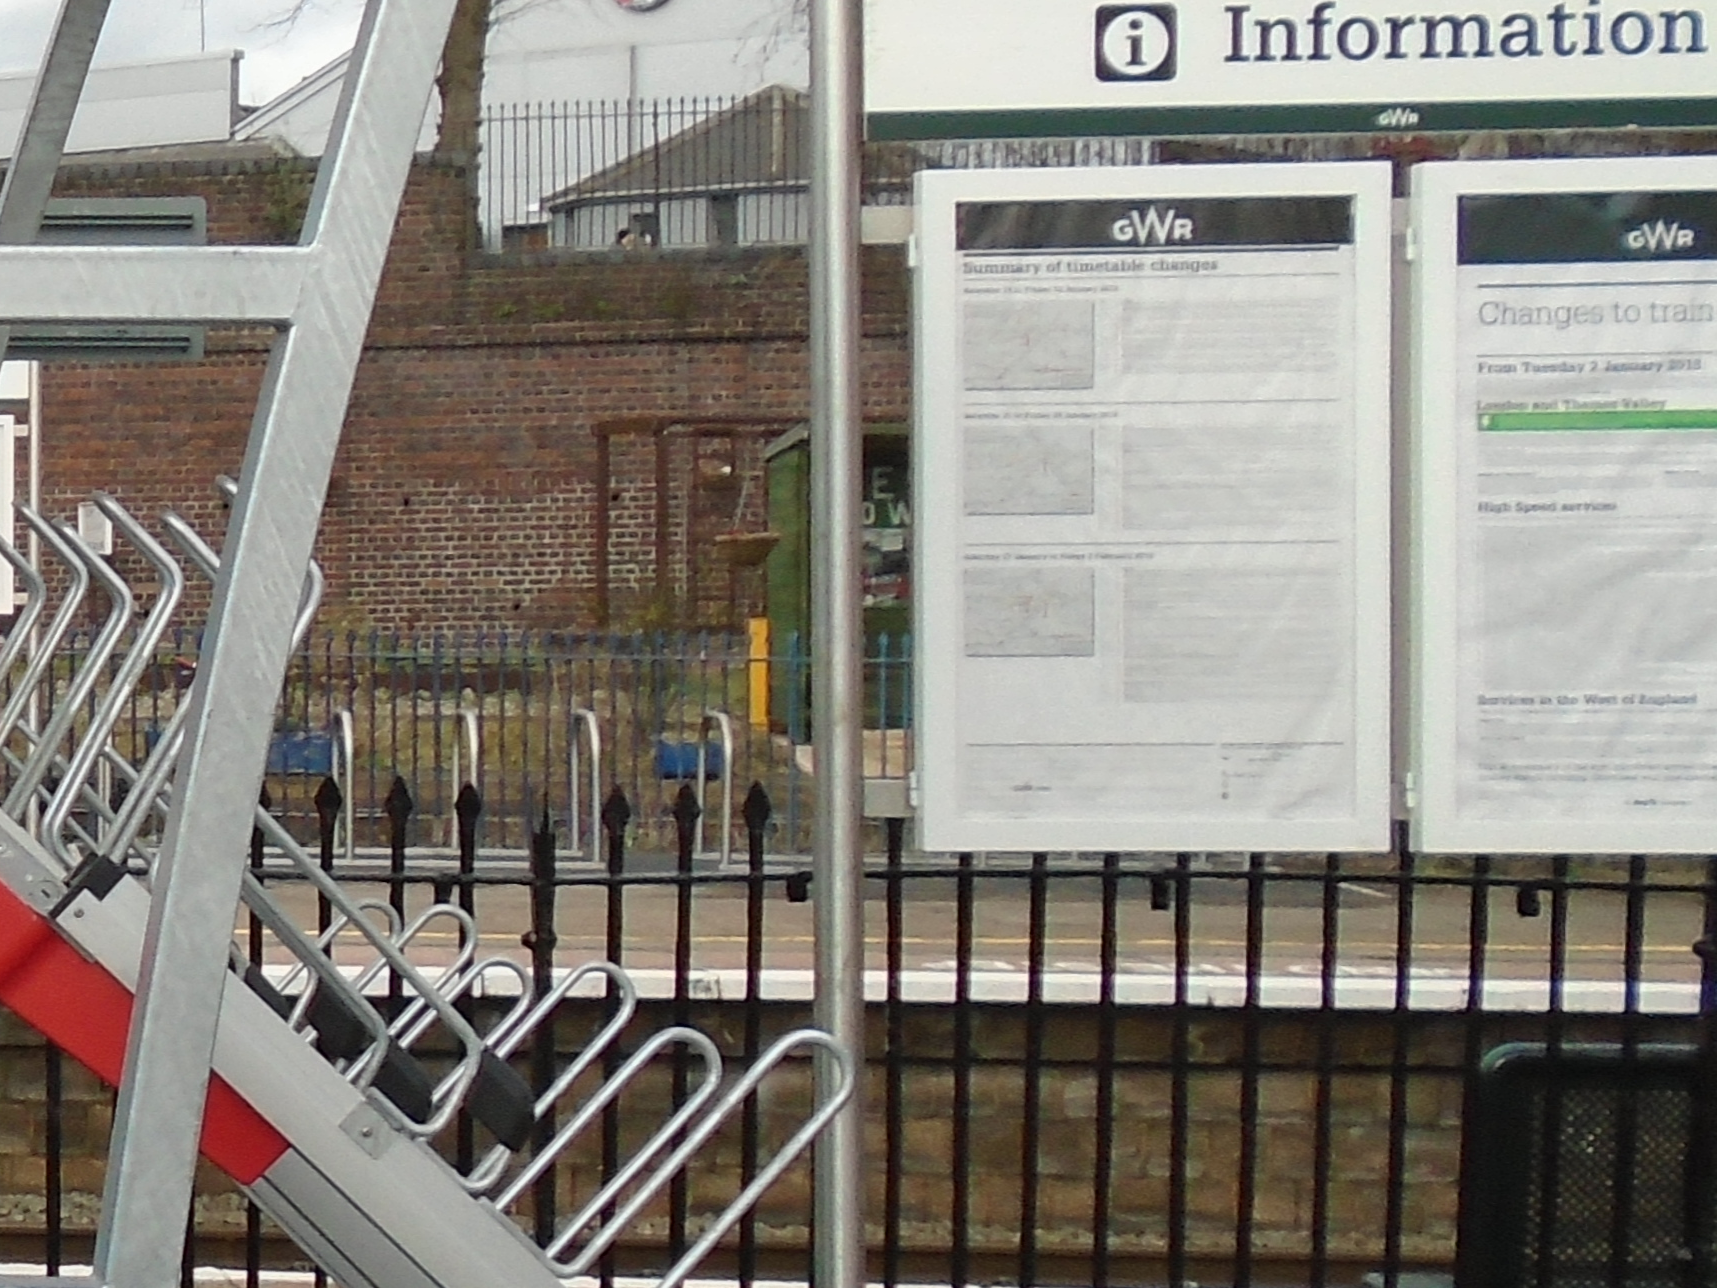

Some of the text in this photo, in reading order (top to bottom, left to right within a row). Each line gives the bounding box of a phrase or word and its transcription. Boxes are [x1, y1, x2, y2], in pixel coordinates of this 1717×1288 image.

[1378, 108, 1418, 128] GWR
[1112, 206, 1193, 244] GWR
[1628, 219, 1694, 253] GWR
[963, 258, 1218, 275] Summary of timetable changes
[1479, 300, 1603, 330] Changes
[1614, 301, 1640, 323] to
[1478, 362, 1516, 373] From
[1524, 362, 1584, 374] Tuesday
[1591, 362, 1598, 372] 2
[1605, 360, 1662, 374] January
